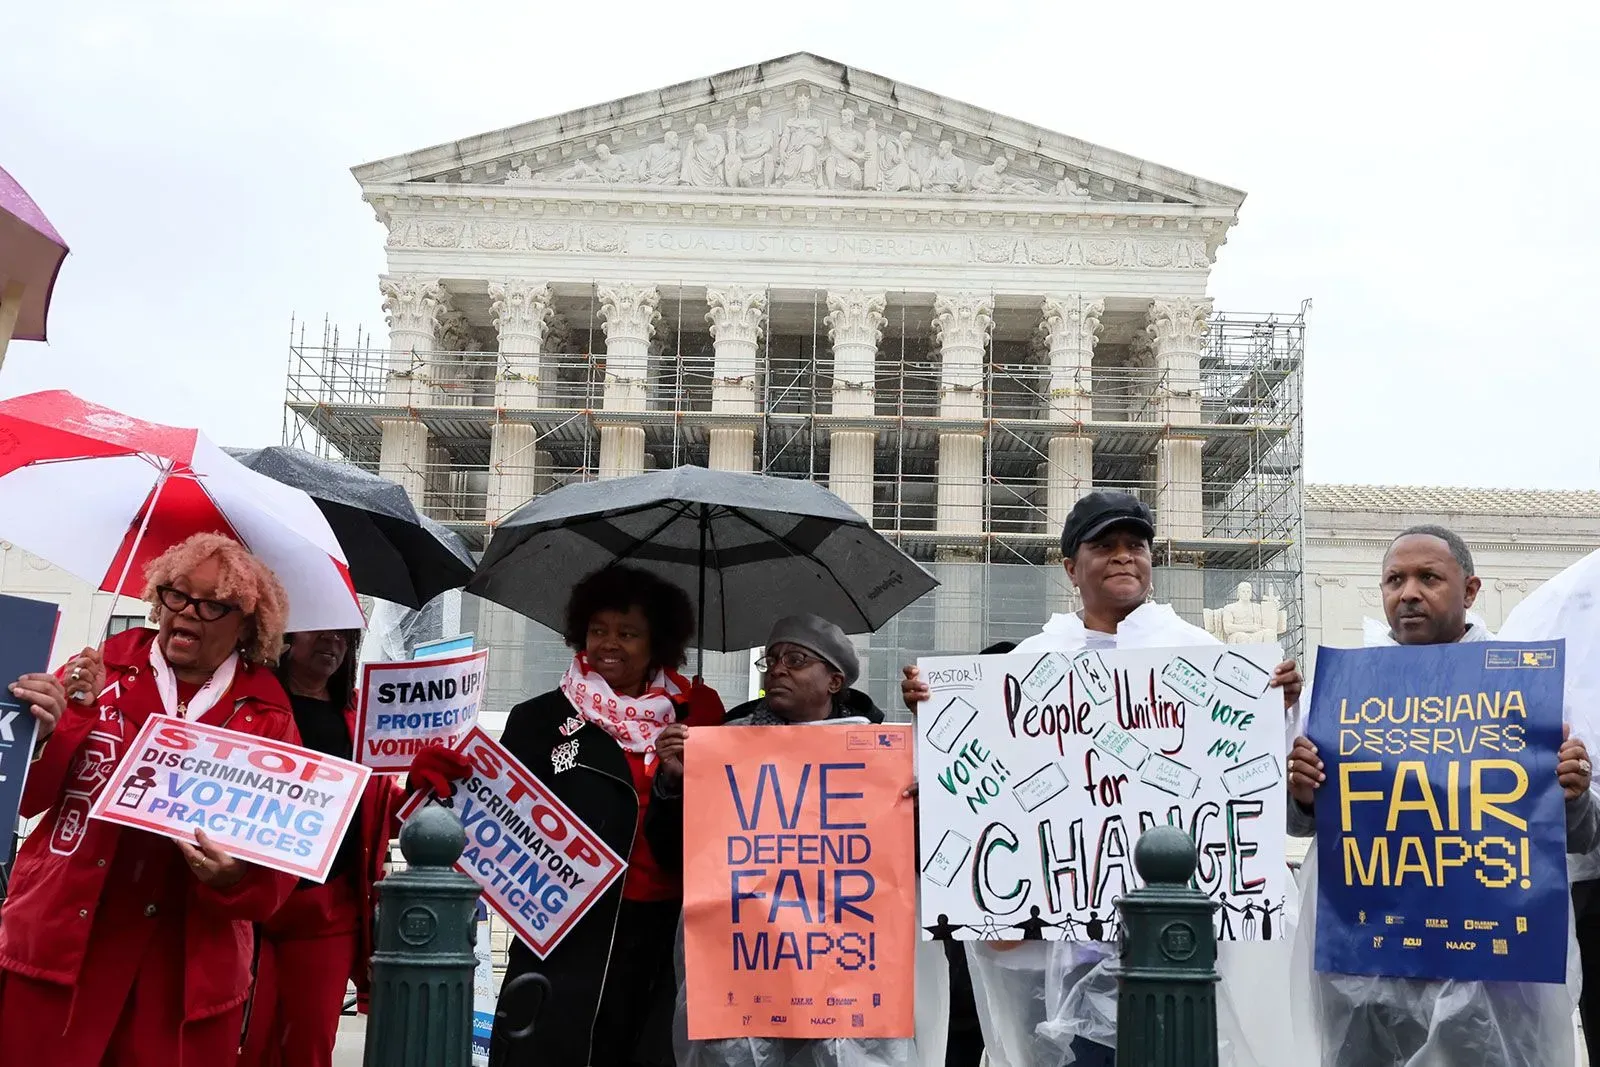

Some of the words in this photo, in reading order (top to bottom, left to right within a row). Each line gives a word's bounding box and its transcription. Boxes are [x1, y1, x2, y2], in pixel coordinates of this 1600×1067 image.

[644, 233, 720, 251] EQUAL
[725, 234, 814, 253] JUSTICE
[824, 237, 900, 255] UNDER
[909, 239, 952, 256] LAW
[377, 678, 457, 704] STAND
[462, 671, 482, 695] UP!
[928, 662, 983, 684] PASTOR!!
[377, 707, 460, 730] PROTECT
[1003, 670, 1093, 757] People
[1113, 667, 1186, 755] Uniting
[1211, 698, 1255, 731] VOTE
[1340, 690, 1527, 724] LOUISIANA
[153, 728, 344, 783] STOP
[937, 738, 990, 795] VOTE
[1207, 738, 1246, 763] NO!
[1340, 724, 1526, 756] DESERVES
[141, 747, 335, 809] DISCRIMINATORY
[167, 772, 325, 837] VOTING
[725, 763, 867, 830] WE
[966, 757, 1011, 815] NO!!
[1084, 748, 1129, 808] for
[1338, 759, 1529, 832] FAIR
[147, 797, 314, 857] PRACTICES
[468, 744, 602, 868] STOP
[460, 797, 569, 915] VOTING
[727, 834, 871, 865] DEFEND
[972, 800, 1266, 915] CHAGE
[1342, 836, 1531, 889] MAPS!
[731, 868, 876, 924] FAIR
[733, 932, 876, 971] MAPS!
[1403, 937, 1422, 946] ACLU
[1446, 941, 1477, 950] NAACP
[811, 1017, 836, 1025] NAACP
